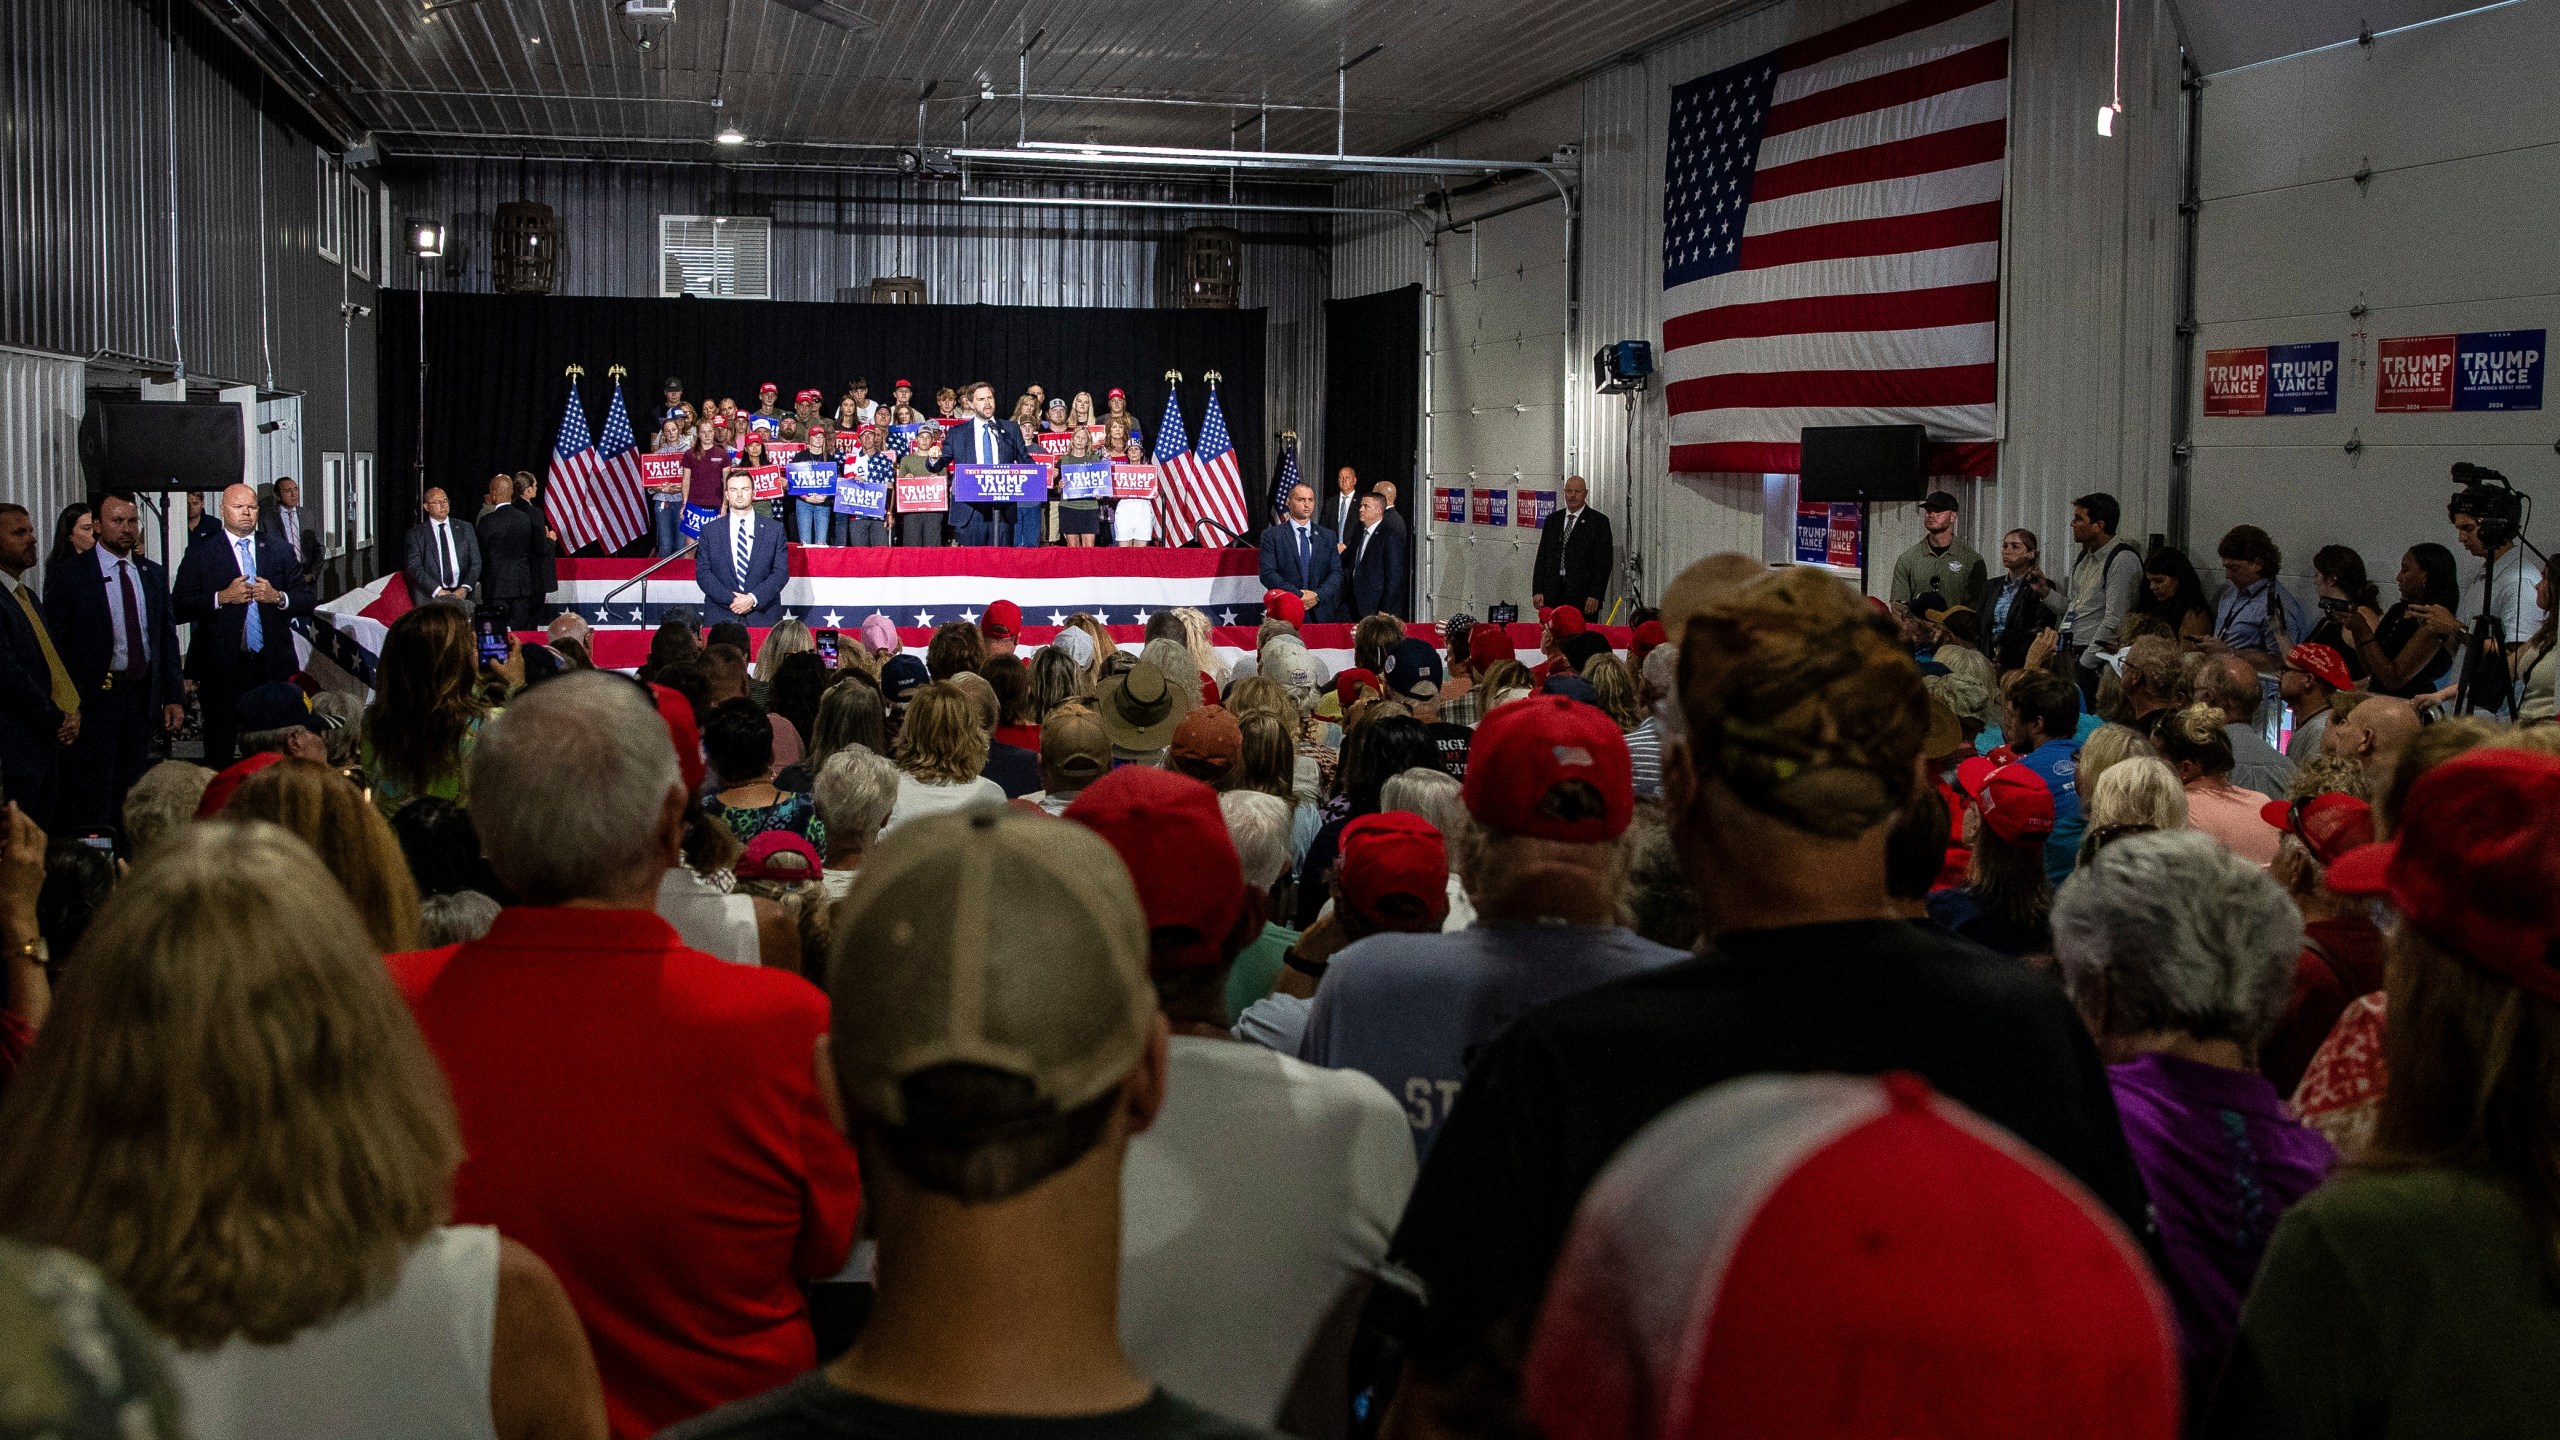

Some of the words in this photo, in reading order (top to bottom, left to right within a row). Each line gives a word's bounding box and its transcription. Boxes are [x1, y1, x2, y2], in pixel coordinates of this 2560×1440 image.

[2382, 354, 2451, 374] TRUMP
[2461, 350, 2539, 370] TRUMP
[2208, 364, 2265, 382] TRUMP
[2272, 360, 2334, 379] TRUMP
[2389, 372, 2442, 388] VANCE
[2469, 369, 2528, 385] VANCE
[2214, 380, 2258, 394] VANCE
[2278, 377, 2326, 392] VANCE
[1041, 438, 1070, 449] TRU
[754, 472, 778, 483] UMP
[790, 470, 834, 480] TRUMP
[976, 475, 1028, 484] TRUMP
[1064, 470, 1108, 481] TRUMP
[1112, 472, 1155, 482] TRUMP
[754, 482, 776, 490] NCE
[900, 484, 944, 494] TRUMP
[981, 484, 1022, 492] VANCE
[1071, 480, 1104, 488] VANCE
[840, 486, 884, 499] TRUMP
[905, 492, 940, 500] VANCE
[844, 494, 878, 506] VANCE
[1450, 496, 1464, 504] TRUMP
[1490, 498, 1506, 507] TRUMP
[1518, 499, 1534, 508] TRUMP
[1538, 500, 1554, 510] TRUMP
[1798, 526, 1826, 538] TRUMP
[1830, 529, 1854, 542] TRUMP
[1800, 536, 1823, 548] VANCE
[1830, 540, 1852, 552] VANCE
[1437, 739, 1471, 750] RGE
